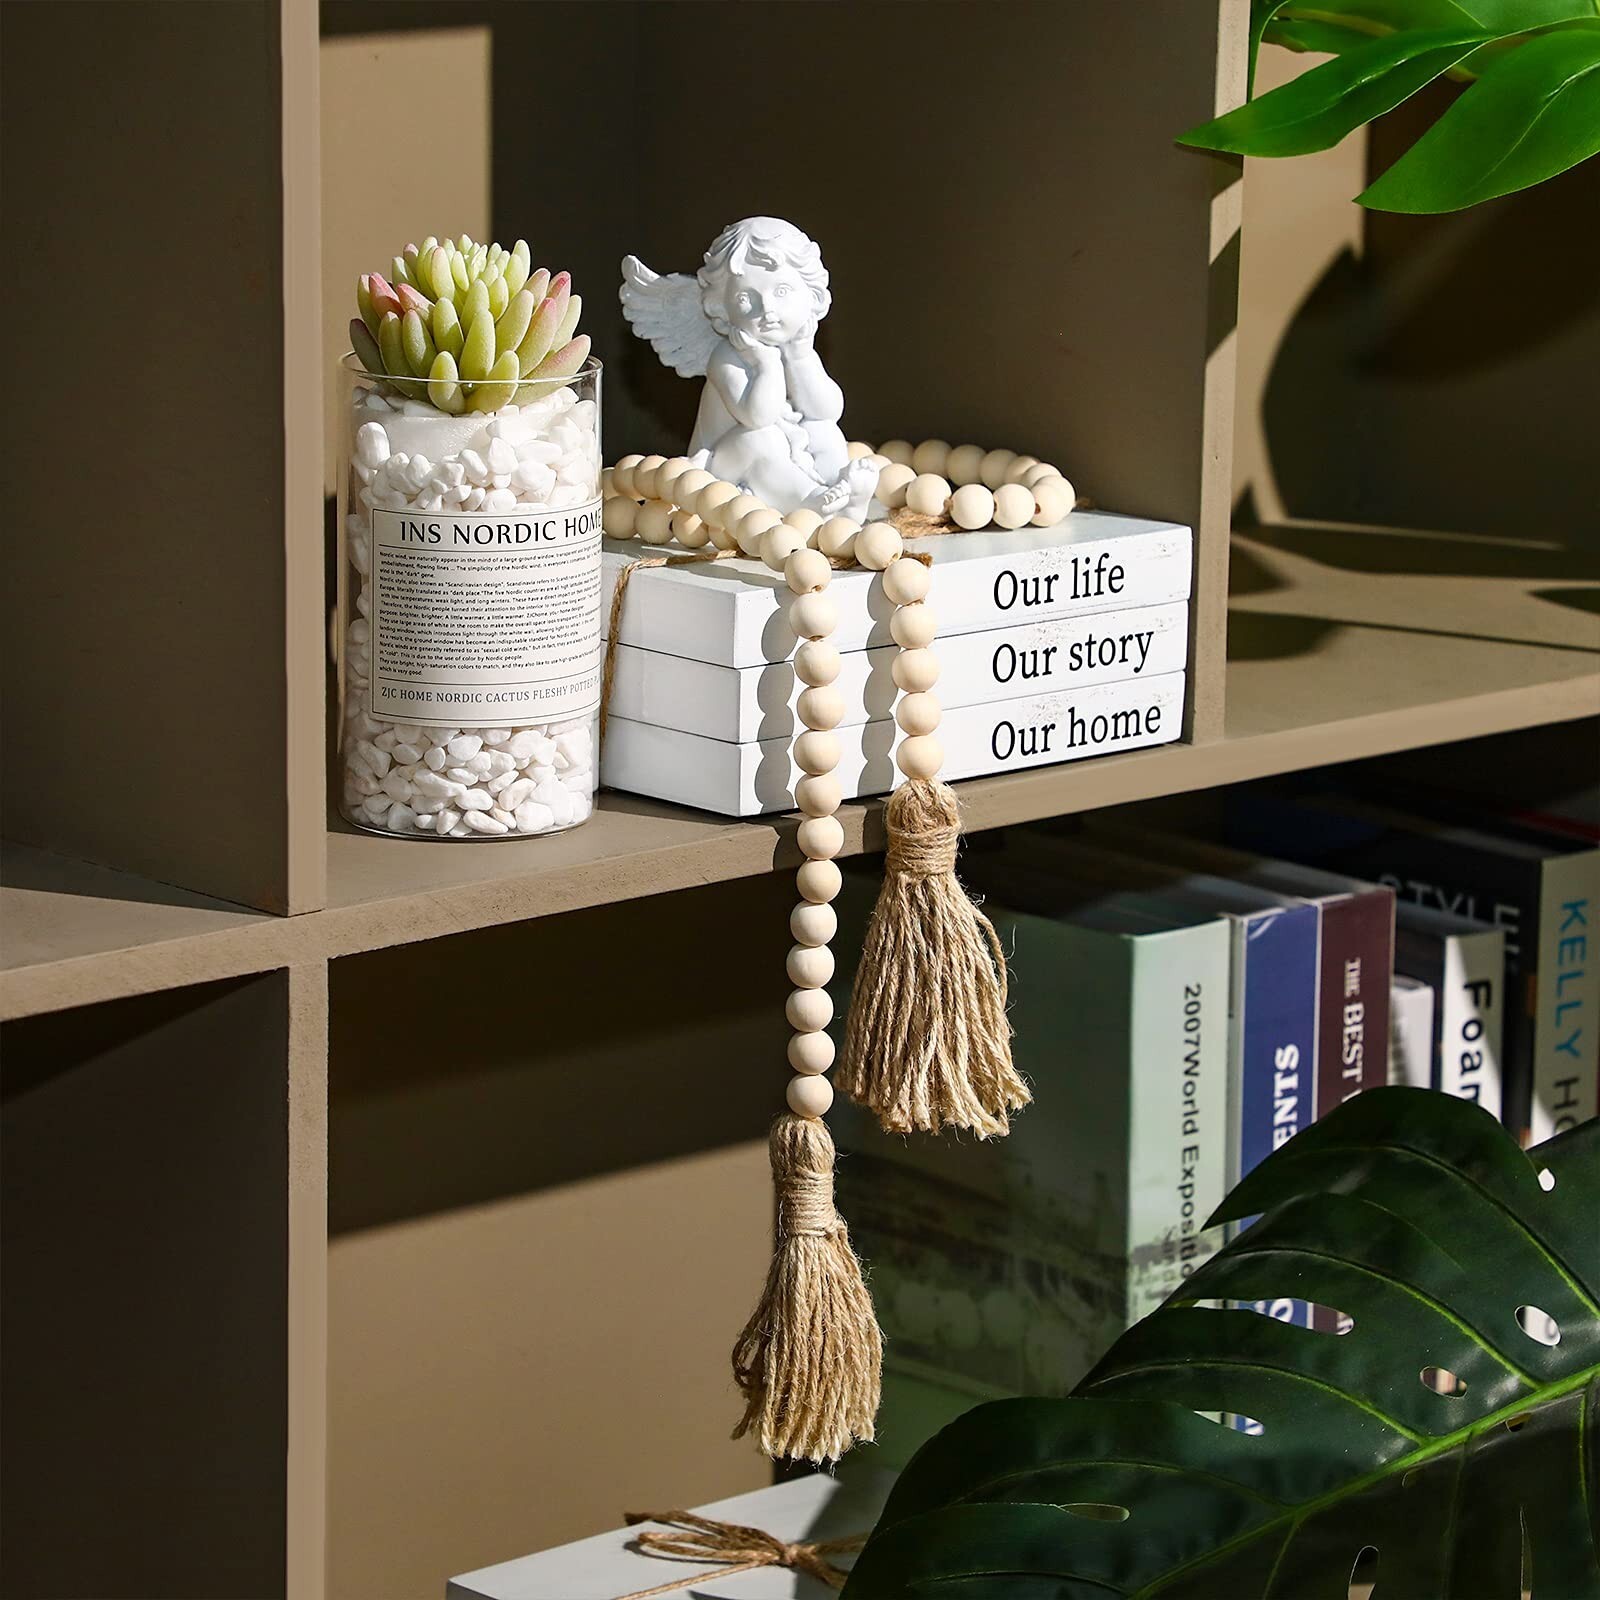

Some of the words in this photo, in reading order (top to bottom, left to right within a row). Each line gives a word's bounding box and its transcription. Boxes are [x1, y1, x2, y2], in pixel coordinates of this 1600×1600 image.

[400, 521, 441, 544] INS
[453, 520, 556, 544] NORDIC
[564, 508, 602, 538] HOME
[416, 555, 439, 563] naturally
[993, 570, 1059, 610] Our
[1070, 552, 1124, 600] life
[417, 645, 442, 653] generally
[992, 643, 1058, 683] Our
[1068, 630, 1154, 674] story
[381, 686, 397, 699] ZJC
[400, 689, 432, 702] HOME
[436, 692, 482, 703] NORDIC
[486, 690, 530, 702] CACTUS
[533, 685, 568, 700] FLESHY
[992, 720, 1056, 760] Our
[1066, 705, 1161, 748] home
[1554, 899, 1588, 1058] KELLY
[1182, 983, 1202, 1136] 2007World
[1342, 1002, 1364, 1082] BEST
[1176, 1144, 1200, 1280] Expositio
